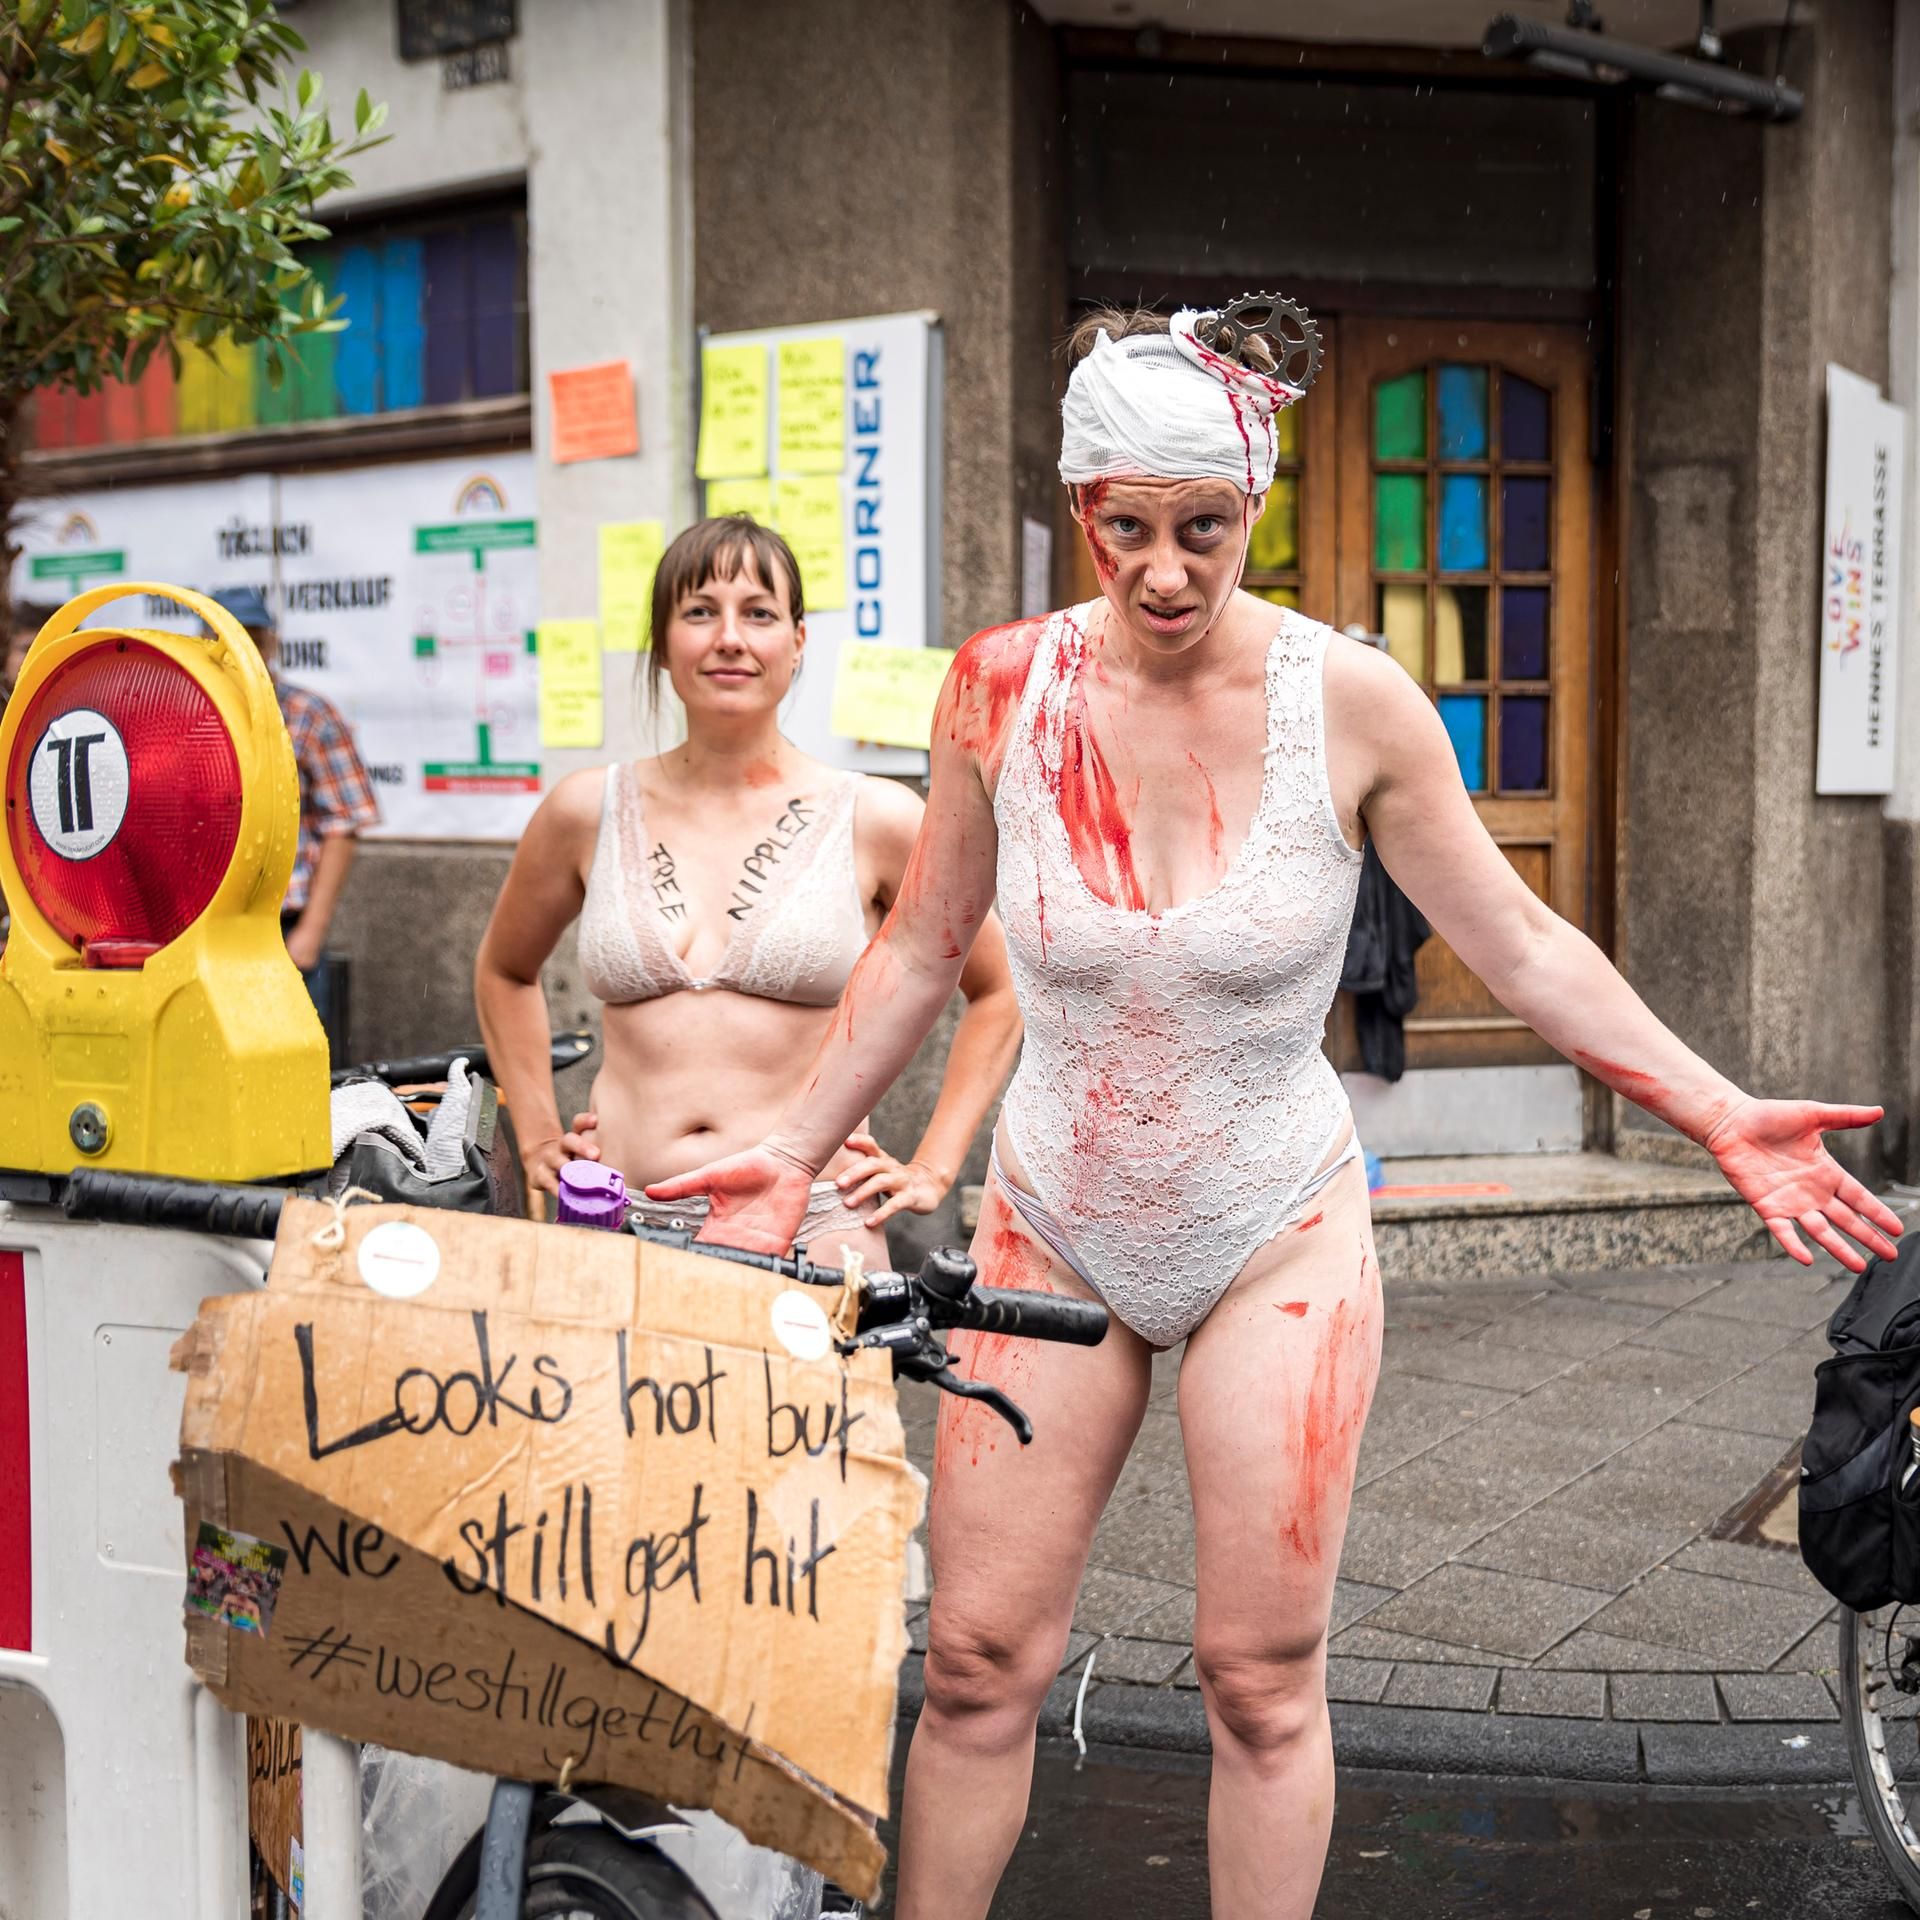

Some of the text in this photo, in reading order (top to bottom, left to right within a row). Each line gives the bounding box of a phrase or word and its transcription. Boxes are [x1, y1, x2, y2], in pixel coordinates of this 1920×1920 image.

[218, 517, 310, 557] TÄGLICH
[854, 346, 882, 637] CORNER
[1827, 527, 1845, 652] LOVE
[1844, 537, 1863, 654] WINS
[1867, 444, 1888, 748] HENNES TERRASSE
[295, 1309, 866, 1483] Looks hot but
[279, 1482, 836, 1667] we still get hit
